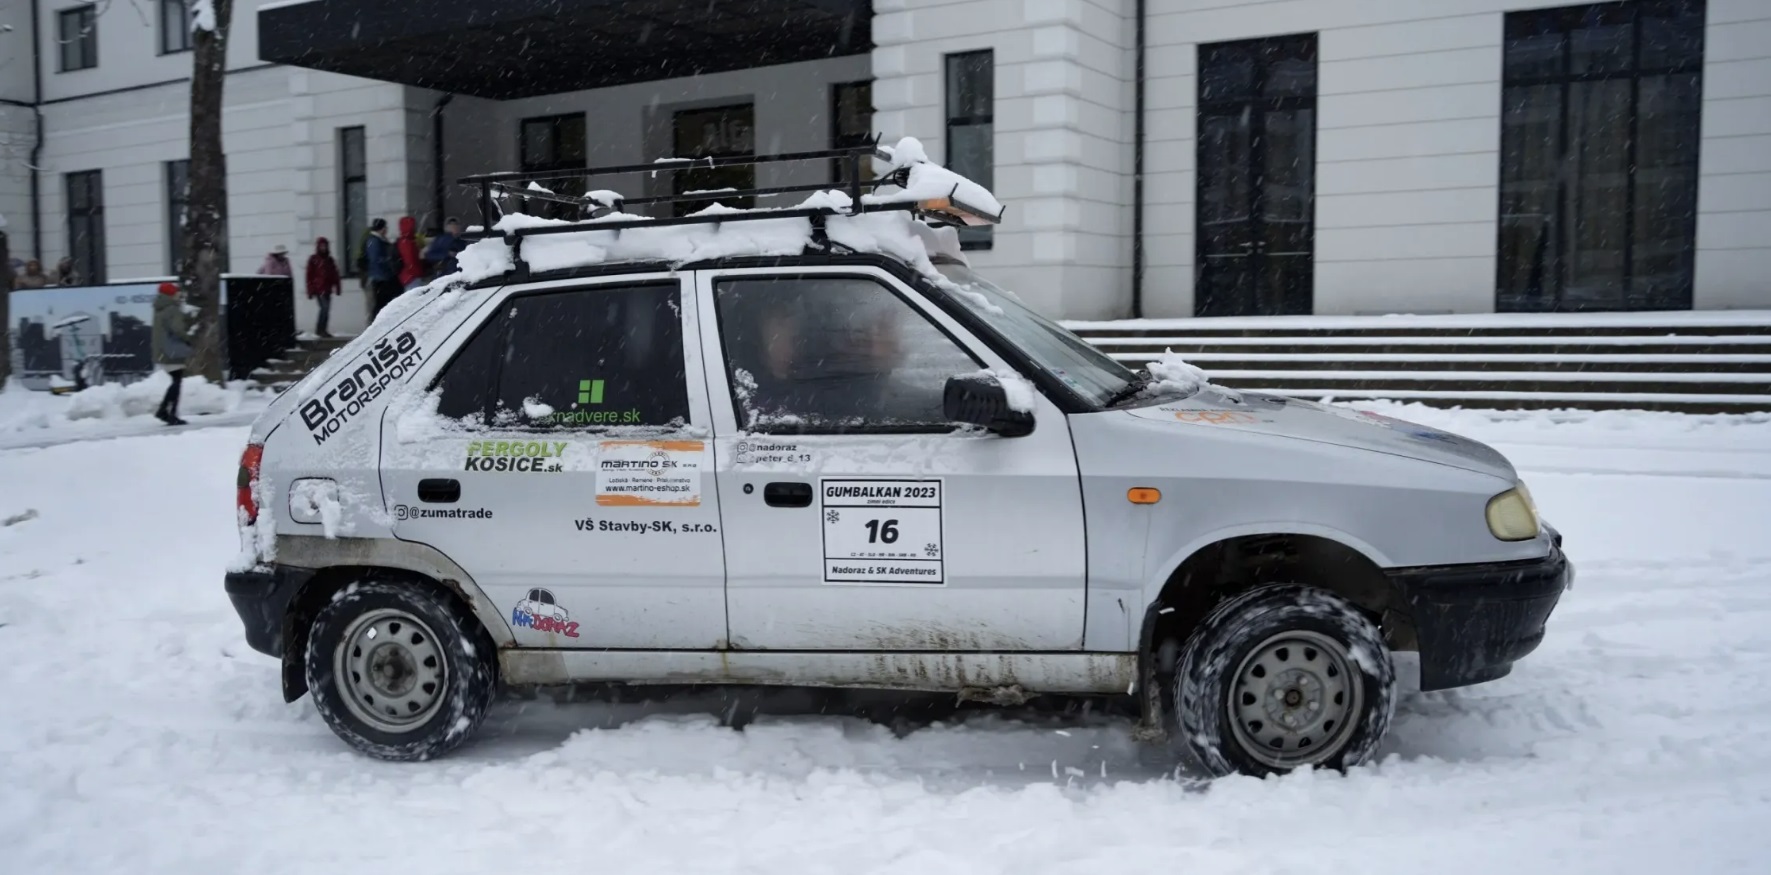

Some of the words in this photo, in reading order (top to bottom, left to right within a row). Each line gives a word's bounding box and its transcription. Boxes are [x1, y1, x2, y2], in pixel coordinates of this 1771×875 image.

[300, 331, 416, 431] Braniša
[313, 346, 422, 445] MOTORSPORT
[467, 441, 567, 457] PERGOLY
[749, 443, 797, 452] @nadoraz
[465, 456, 562, 472] KOSICE.sk
[605, 484, 690, 493] www.martino-eshop.sk
[826, 487, 901, 497] GUMBALKAN
[904, 487, 936, 498] 2023
[409, 506, 493, 519] @zumatrade
[575, 518, 594, 530] VŠ
[599, 520, 677, 535] Stavby-SK,
[681, 523, 717, 532] s.r.o.
[865, 519, 899, 544] 16
[832, 566, 866, 574] Nadoraz
[889, 567, 936, 575] Adventures
